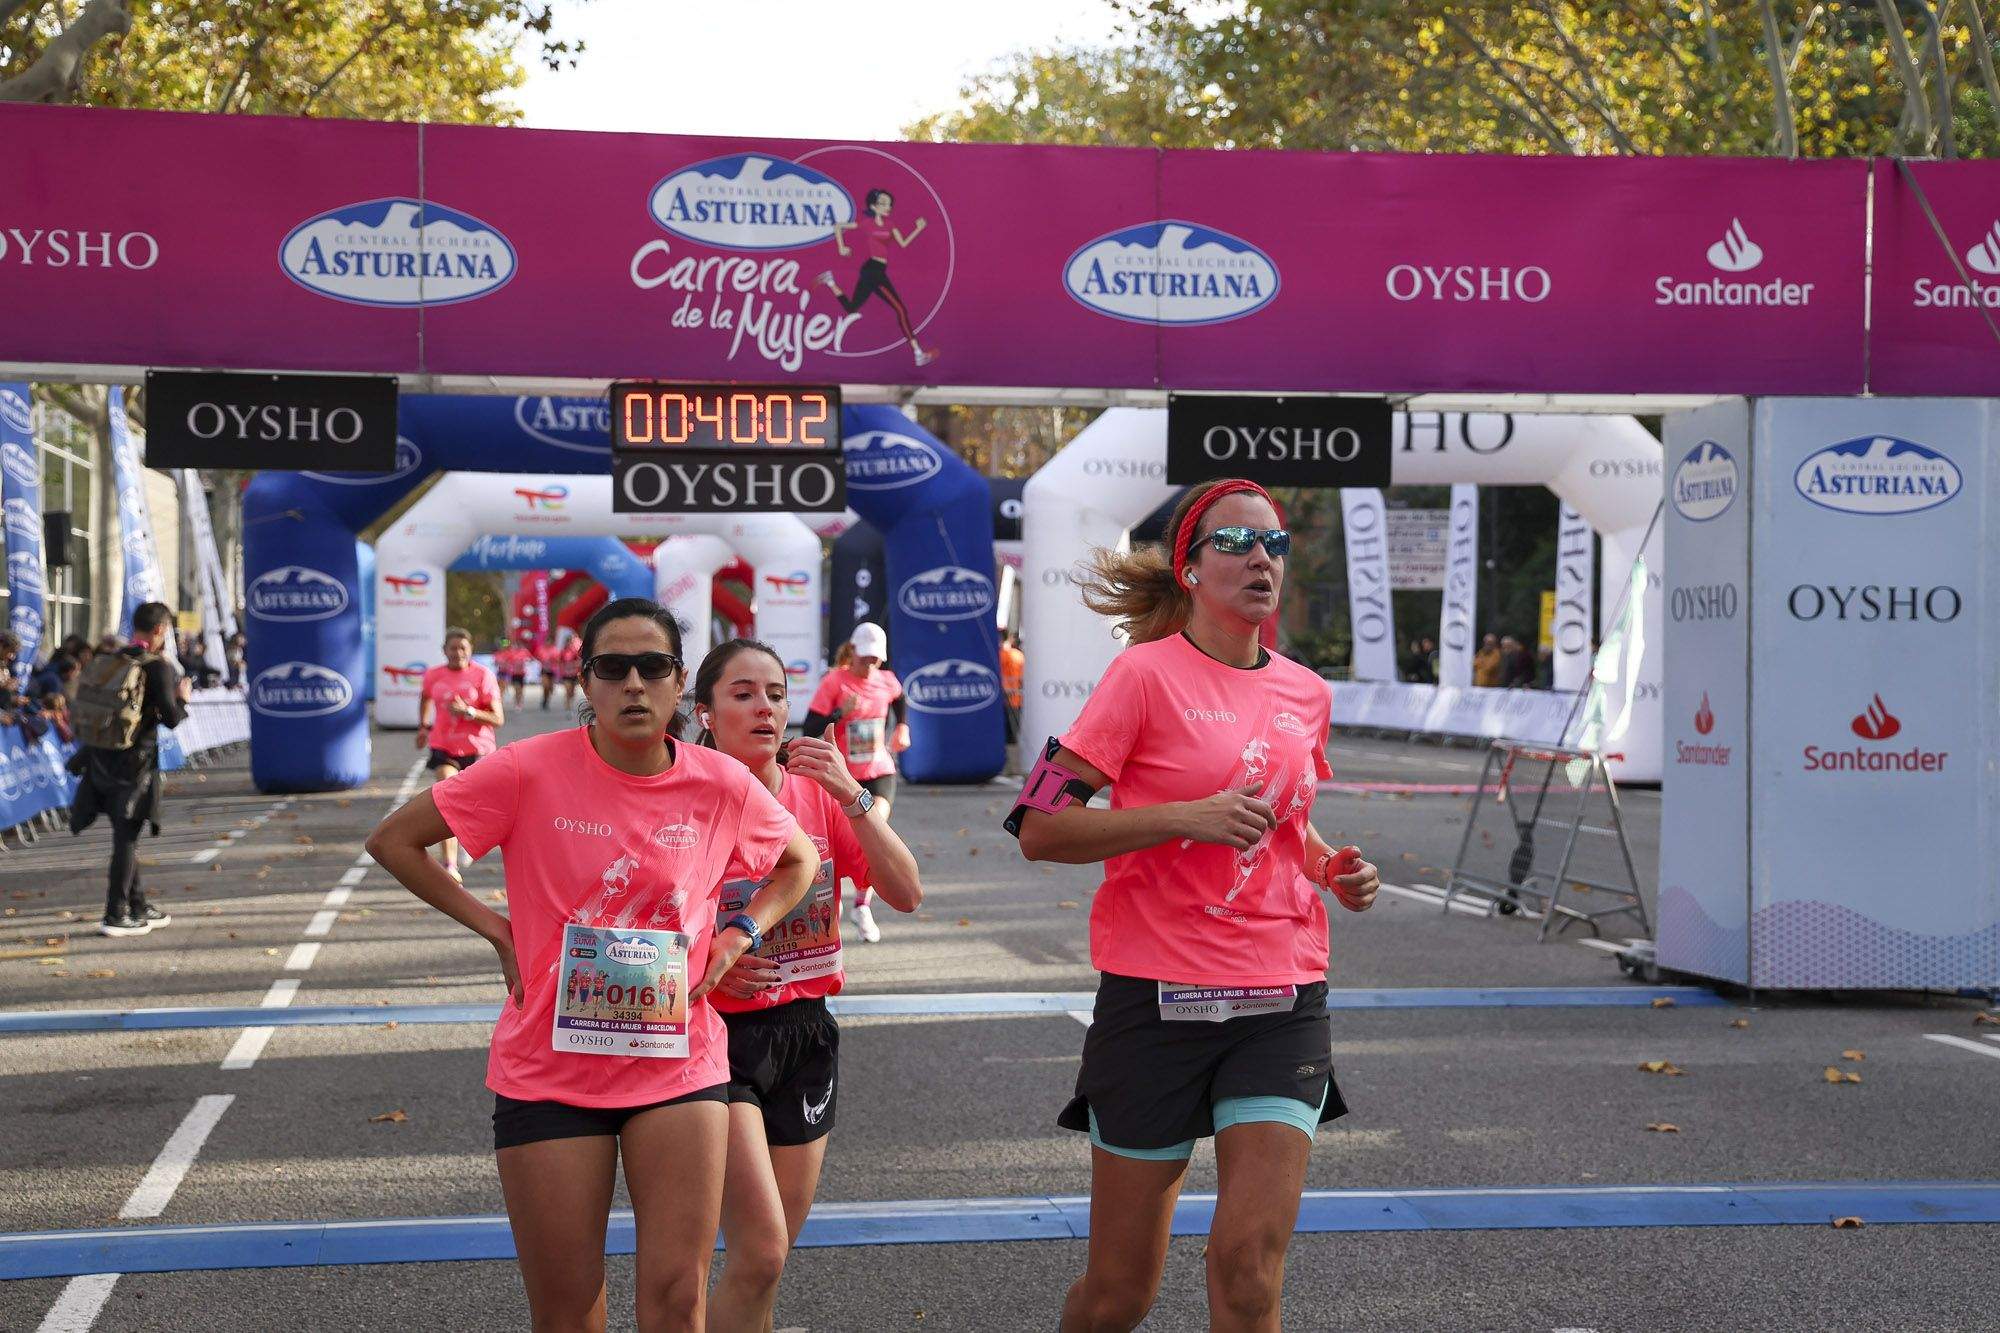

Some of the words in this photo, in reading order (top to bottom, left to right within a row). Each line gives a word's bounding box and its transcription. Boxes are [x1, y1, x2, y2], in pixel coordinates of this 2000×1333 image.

[666, 187, 838, 226] ASTURIANA
[0, 229, 159, 270] YSHO
[299, 236, 498, 278] ASTURIANA
[630, 239, 803, 292] Carrera
[1082, 257, 1262, 297] ASTURIANA
[1386, 265, 1551, 302] OYSHO
[1655, 276, 1814, 306] Santander
[671, 296, 704, 328] de
[709, 294, 733, 330] la
[728, 290, 861, 372] Mujer
[187, 402, 364, 443] OYSHO
[625, 394, 827, 444] 00:40:02
[1204, 425, 1361, 462] OYSHO
[623, 463, 836, 507] OYSHO
[1807, 465, 1949, 495] ASTURIANA
[1350, 503, 1386, 643] OYSHO
[1671, 583, 1738, 622] OYSHO
[1787, 584, 1962, 623] OYSHO
[1185, 708, 1237, 724] OYSHO
[1676, 740, 1731, 766] Santander
[1803, 746, 1948, 773] Santander
[554, 816, 612, 837] OYSHO
[609, 945, 657, 960] ASTURIANA
[770, 941, 798, 954] 18119
[780, 952, 800, 961] MUJER
[803, 944, 837, 957] BARCELONA
[800, 959, 838, 973] Santander
[607, 984, 656, 1006] 016
[1173, 992, 1203, 1000] CARRERA
[1223, 989, 1245, 997] MUJER
[1249, 988, 1283, 996] BARCELONA
[1241, 1001, 1280, 1010] Santander
[613, 1010, 643, 1021] 34394
[1176, 1004, 1219, 1015] OYSHO
[570, 1018, 600, 1029] CARRERA
[601, 1021, 610, 1029] DE
[611, 1022, 619, 1030] LA
[620, 1022, 641, 1031] MUJER
[646, 1024, 677, 1032] BARCELONA
[569, 1033, 614, 1047] OYSHO
[640, 1040, 676, 1050] Santander
